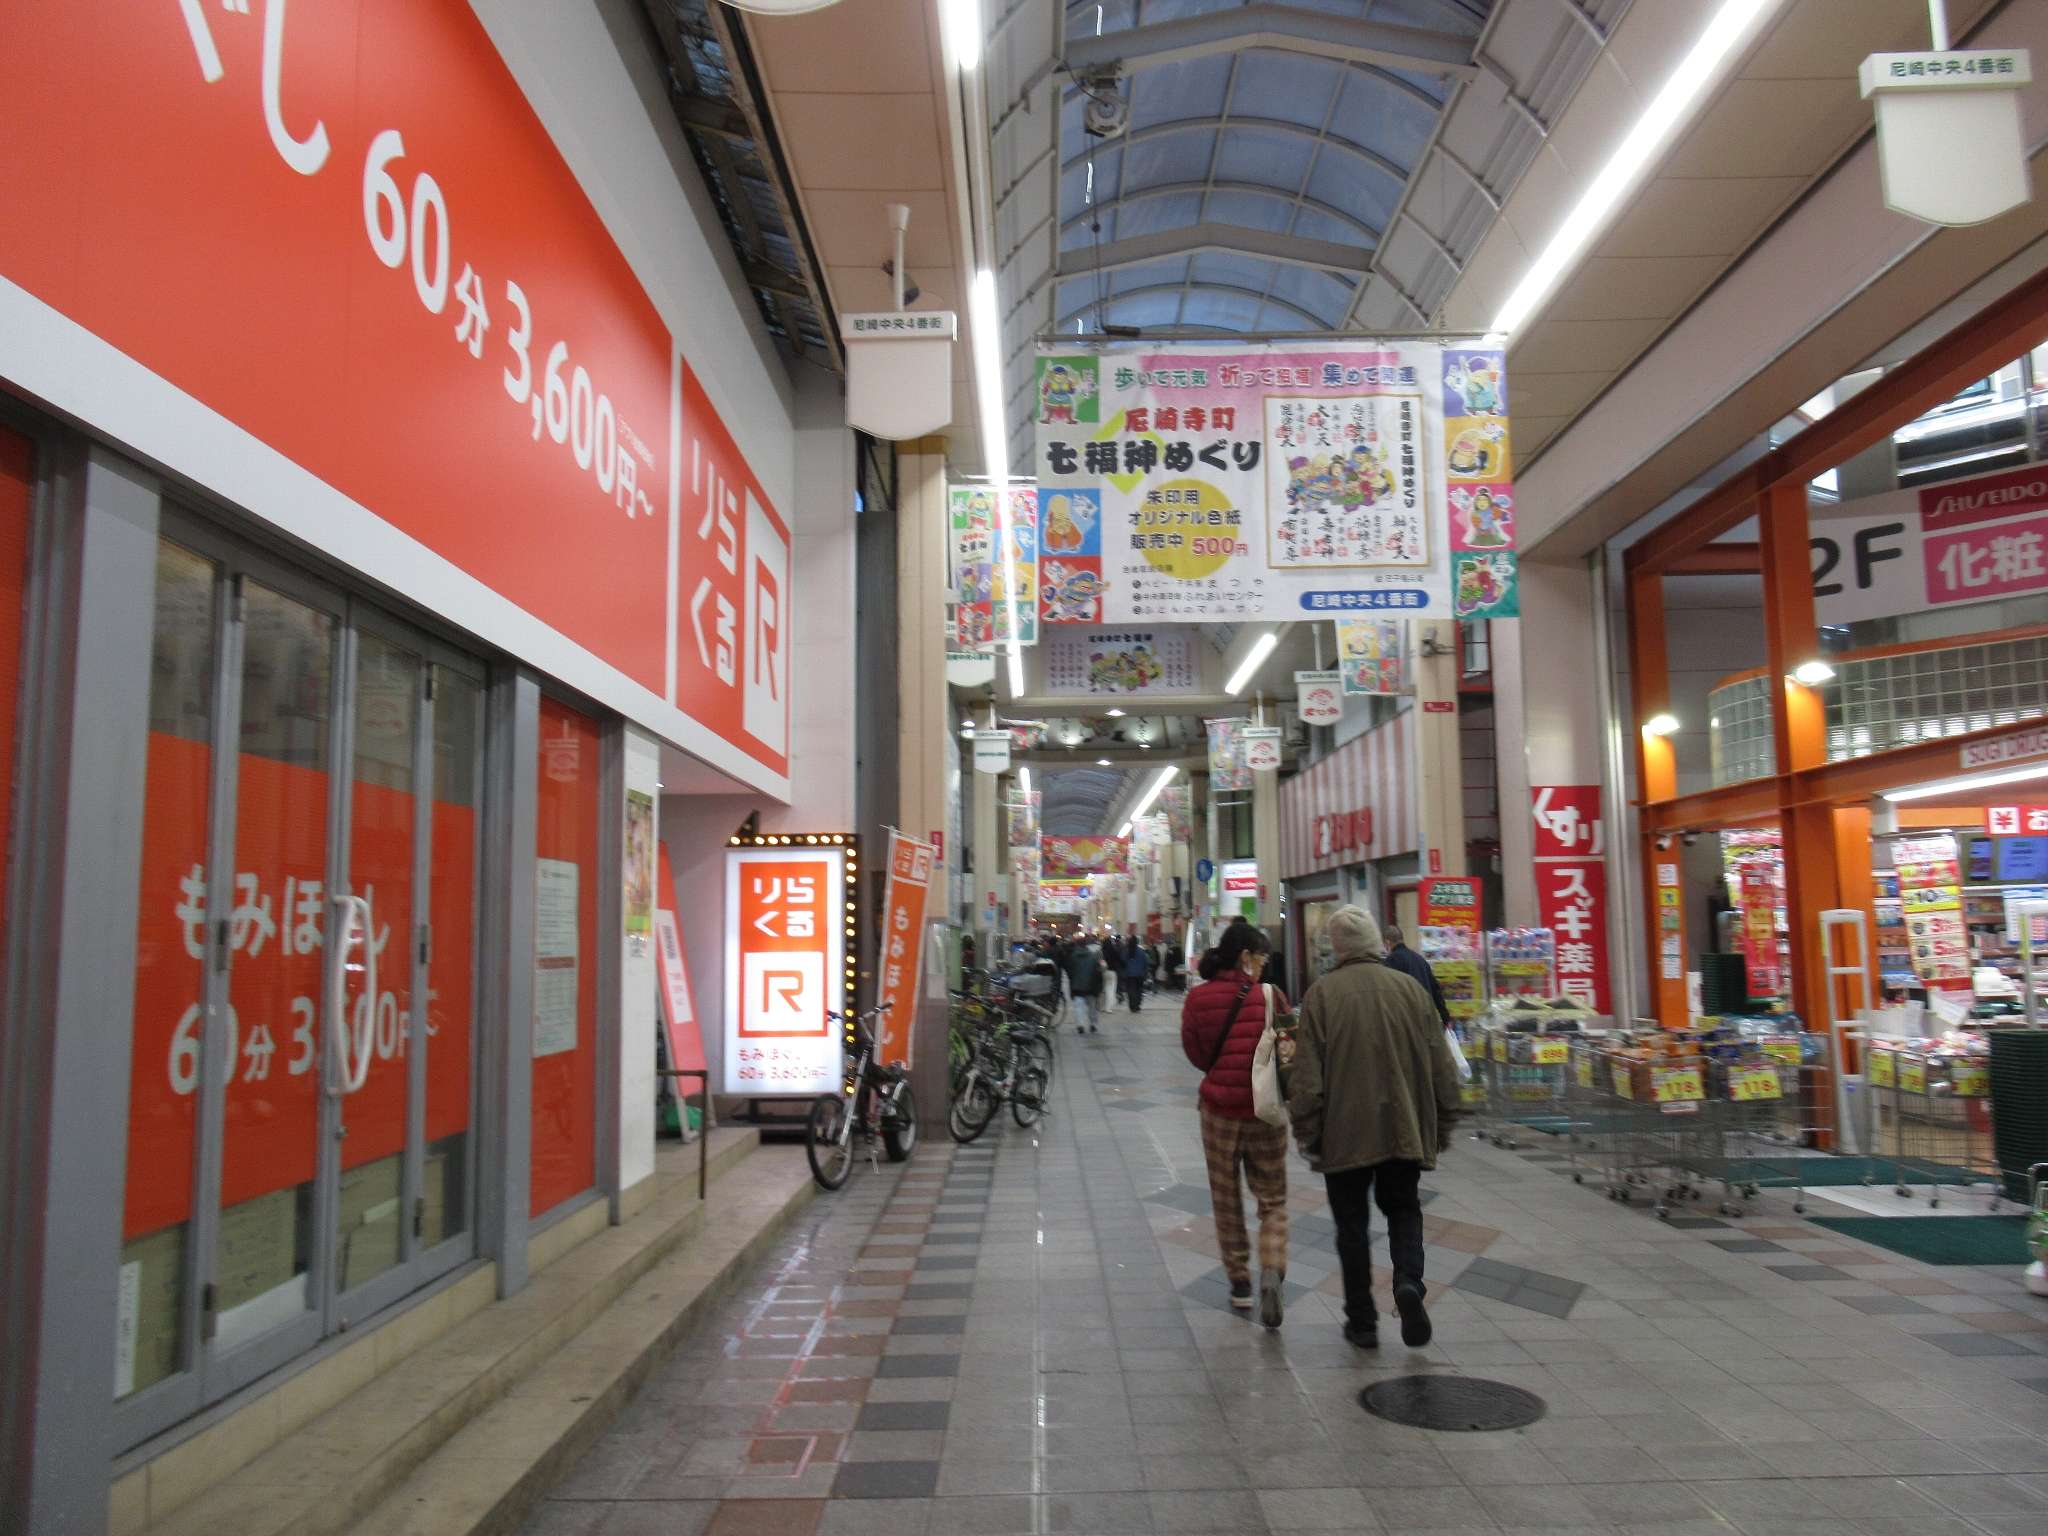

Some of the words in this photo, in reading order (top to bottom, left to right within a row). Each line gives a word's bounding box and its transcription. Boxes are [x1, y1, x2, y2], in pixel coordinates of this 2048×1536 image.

[1889, 56, 2014, 77] 尼崎中央4番街
[1125, 406, 1236, 432] 尼崎寺町
[1046, 438, 1260, 475] 七福神めぐり
[1147, 489, 1199, 505] 朱印用
[1128, 509, 1241, 526] オリジナル色紙
[1130, 533, 1184, 550] 販売中
[1191, 537, 1249, 556] 500円
[1808, 521, 1905, 598] 2F
[1311, 593, 1419, 607] 尼崎中央4番街
[1532, 788, 1605, 854] くすり
[1552, 868, 1598, 1005] スギ薬局
